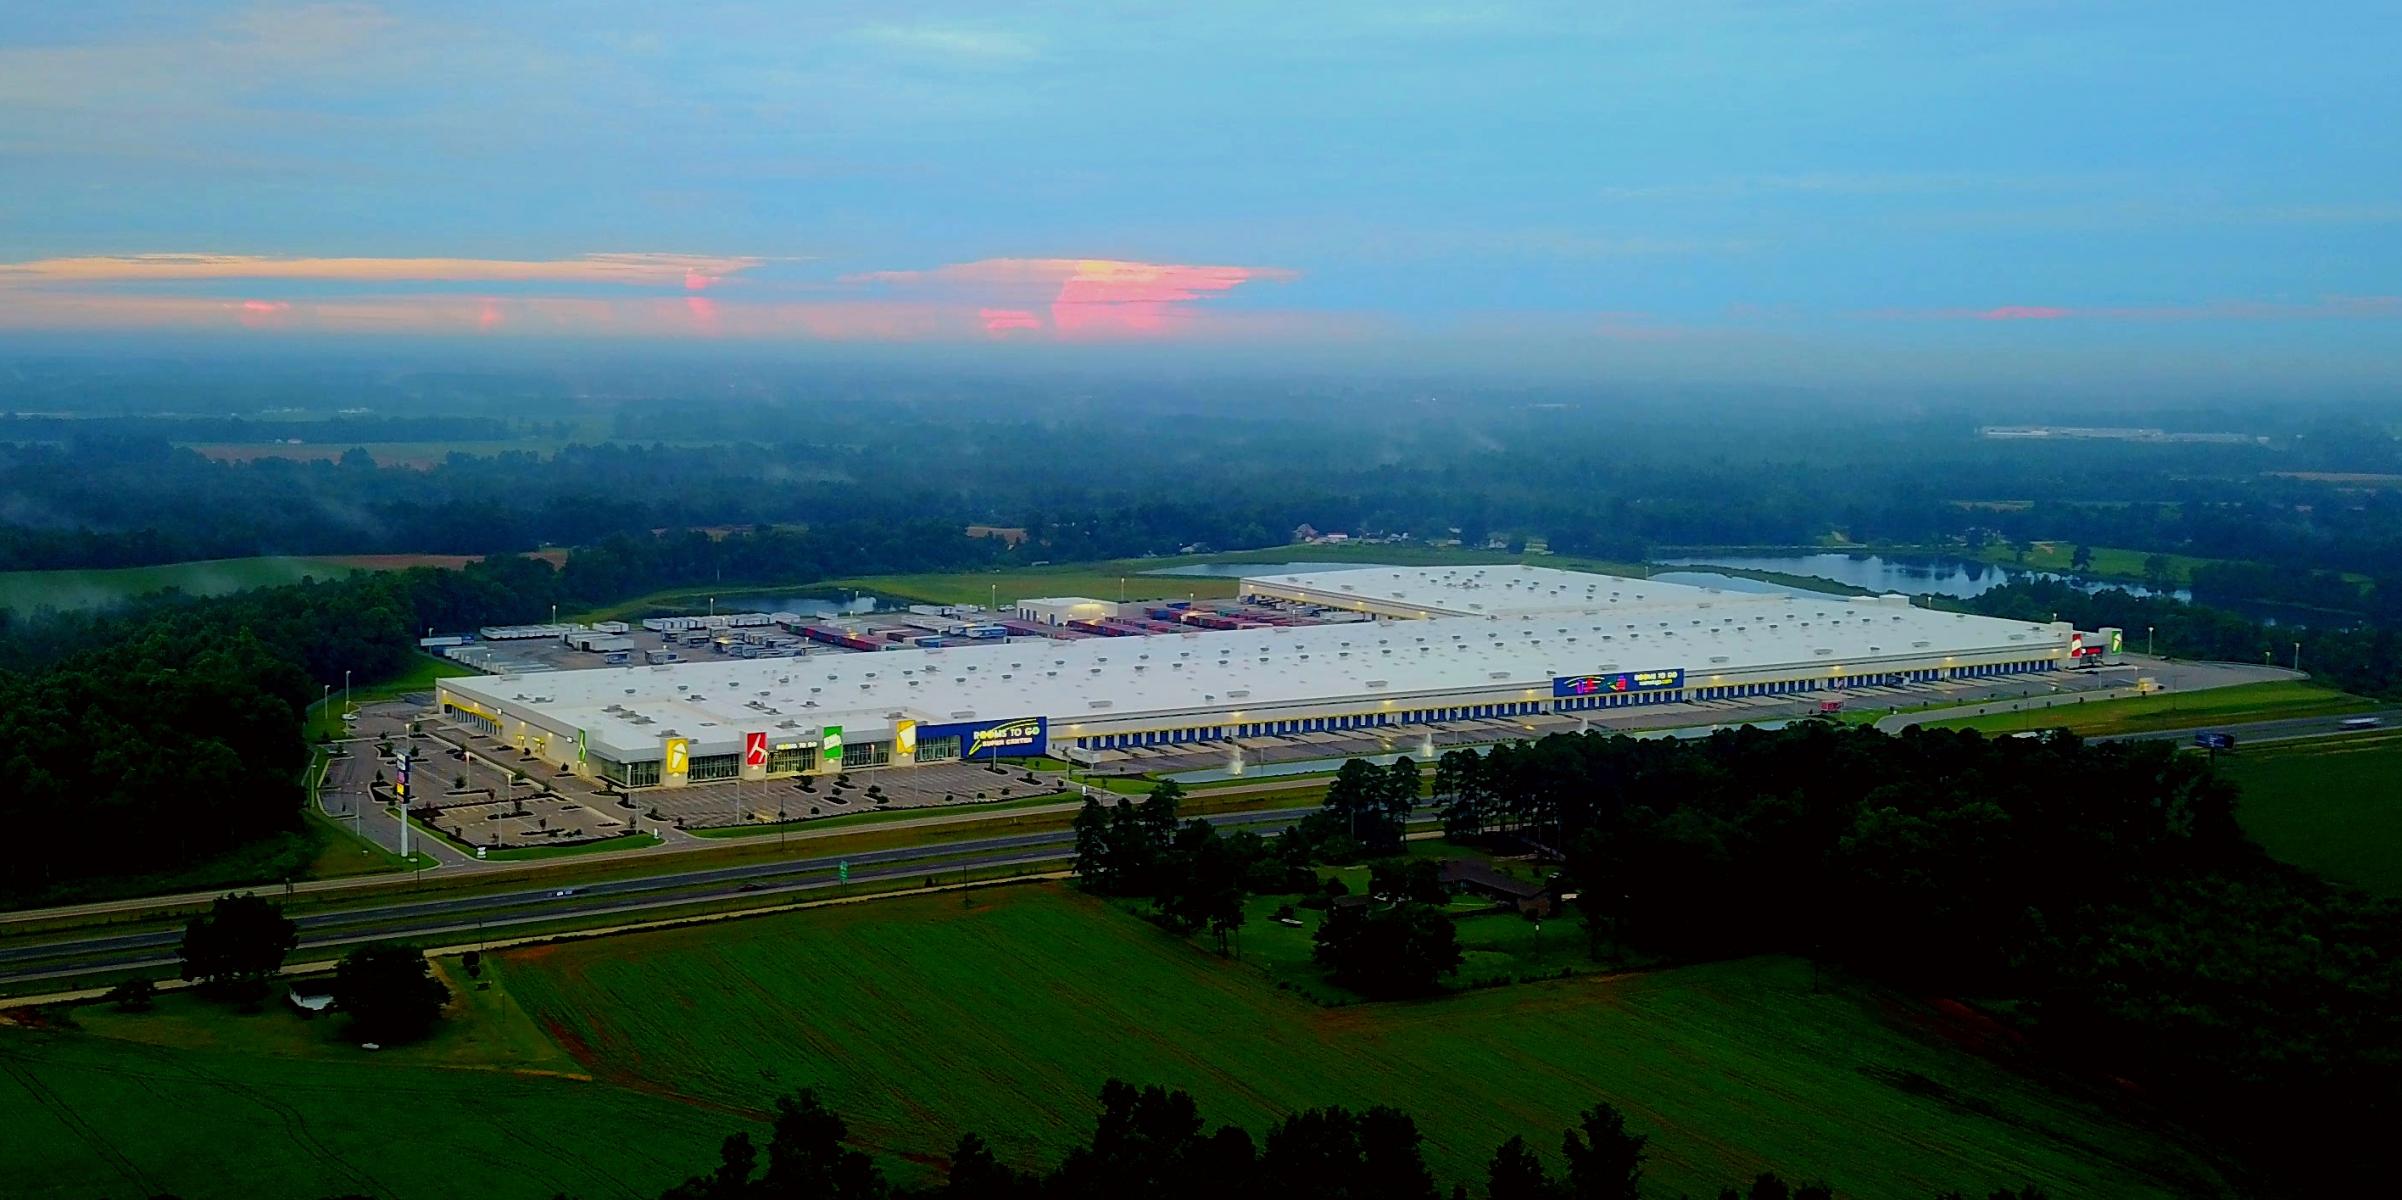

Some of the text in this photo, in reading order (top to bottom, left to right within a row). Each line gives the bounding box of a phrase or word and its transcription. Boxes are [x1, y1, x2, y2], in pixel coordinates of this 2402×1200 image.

[974, 726, 1040, 740] ROOMS TO GO
